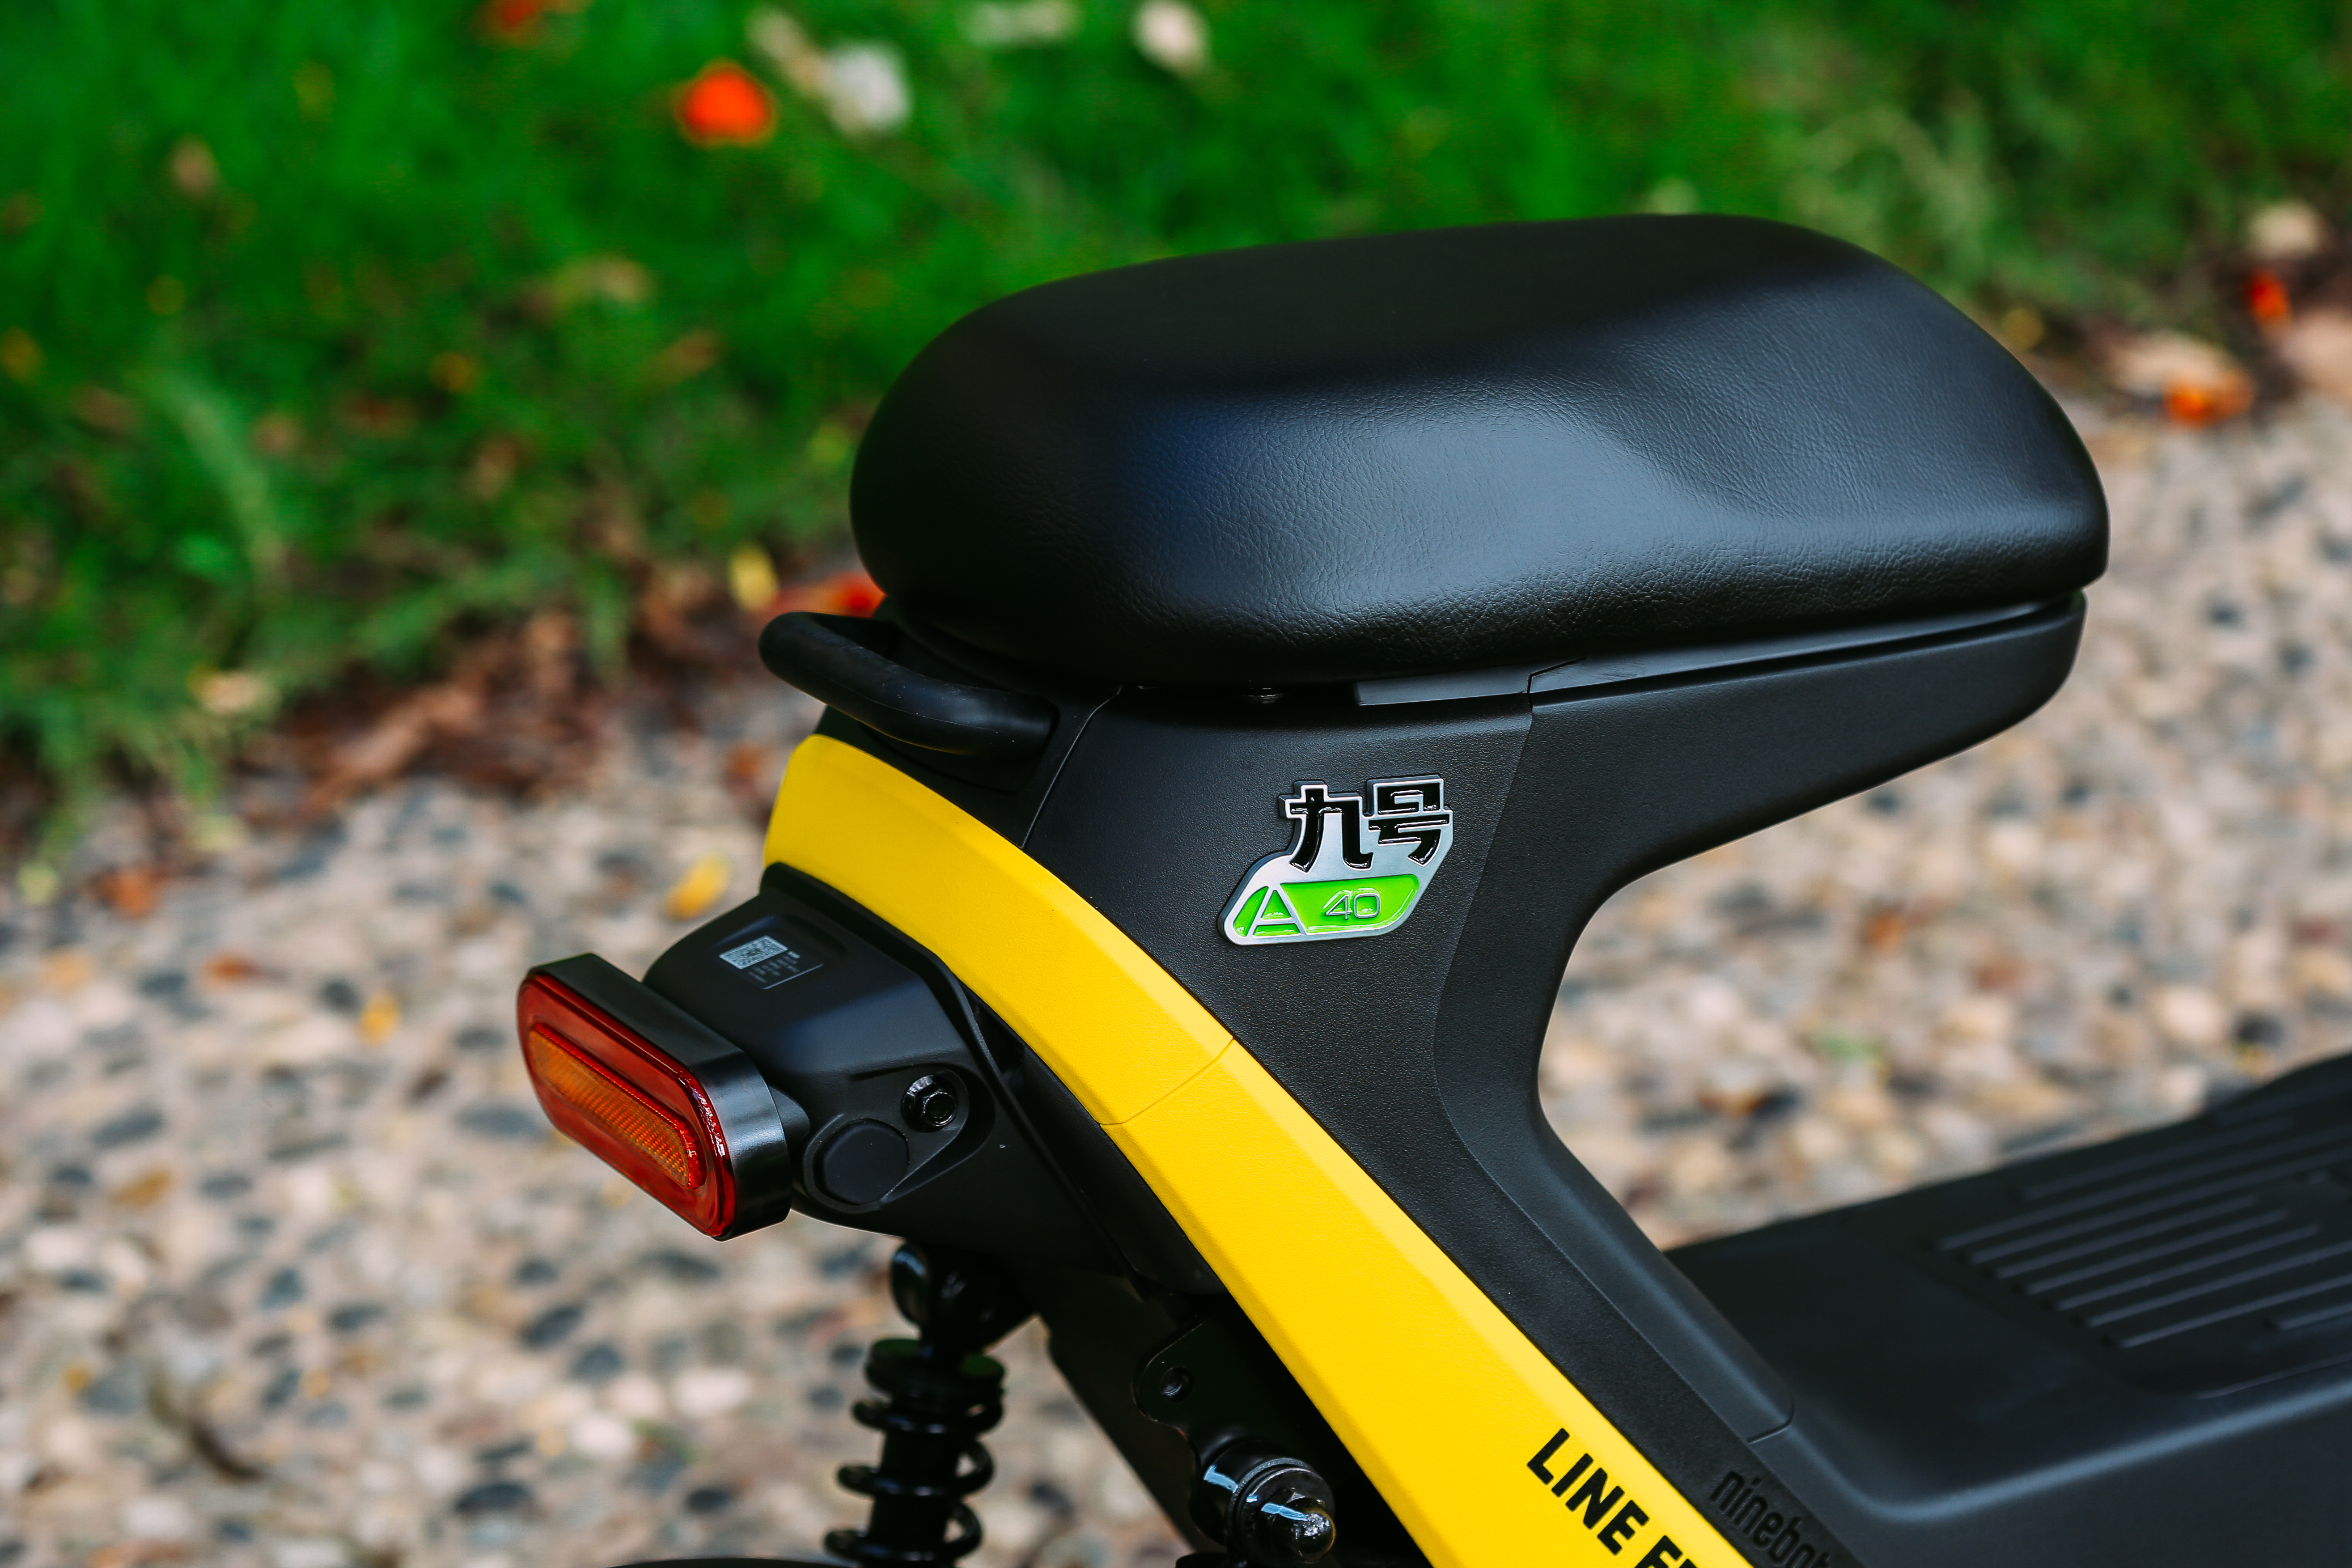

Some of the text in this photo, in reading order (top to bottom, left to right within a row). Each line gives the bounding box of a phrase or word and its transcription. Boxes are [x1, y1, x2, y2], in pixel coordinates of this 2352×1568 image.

[1288, 780, 1451, 873] 九号
[1246, 884, 1381, 937] A 40
[1526, 1428, 1650, 1556] LINE
